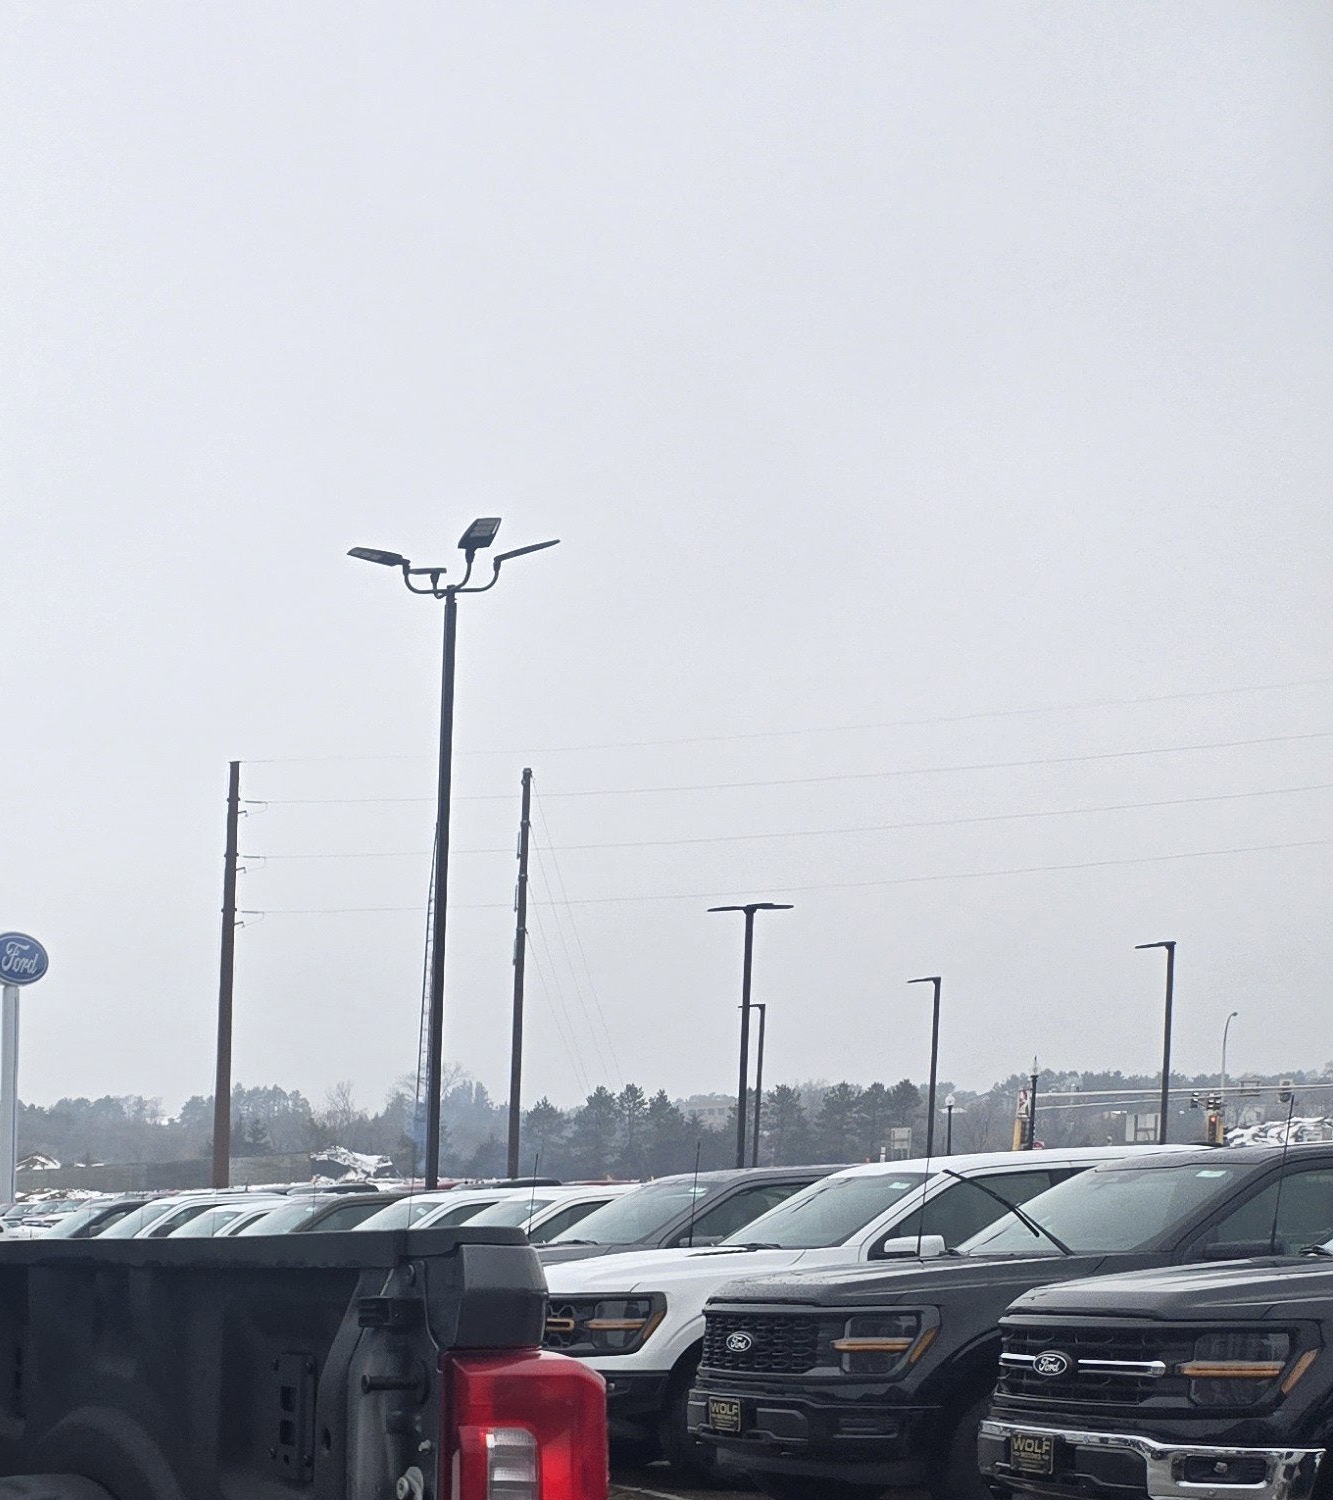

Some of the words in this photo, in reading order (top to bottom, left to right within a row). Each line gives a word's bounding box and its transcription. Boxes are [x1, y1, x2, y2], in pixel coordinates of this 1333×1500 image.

[1, 941, 39, 975] Ford
[1038, 1356, 1061, 1372] Ford
[711, 1402, 738, 1416] WOLF
[1013, 1436, 1051, 1454] WOLF
